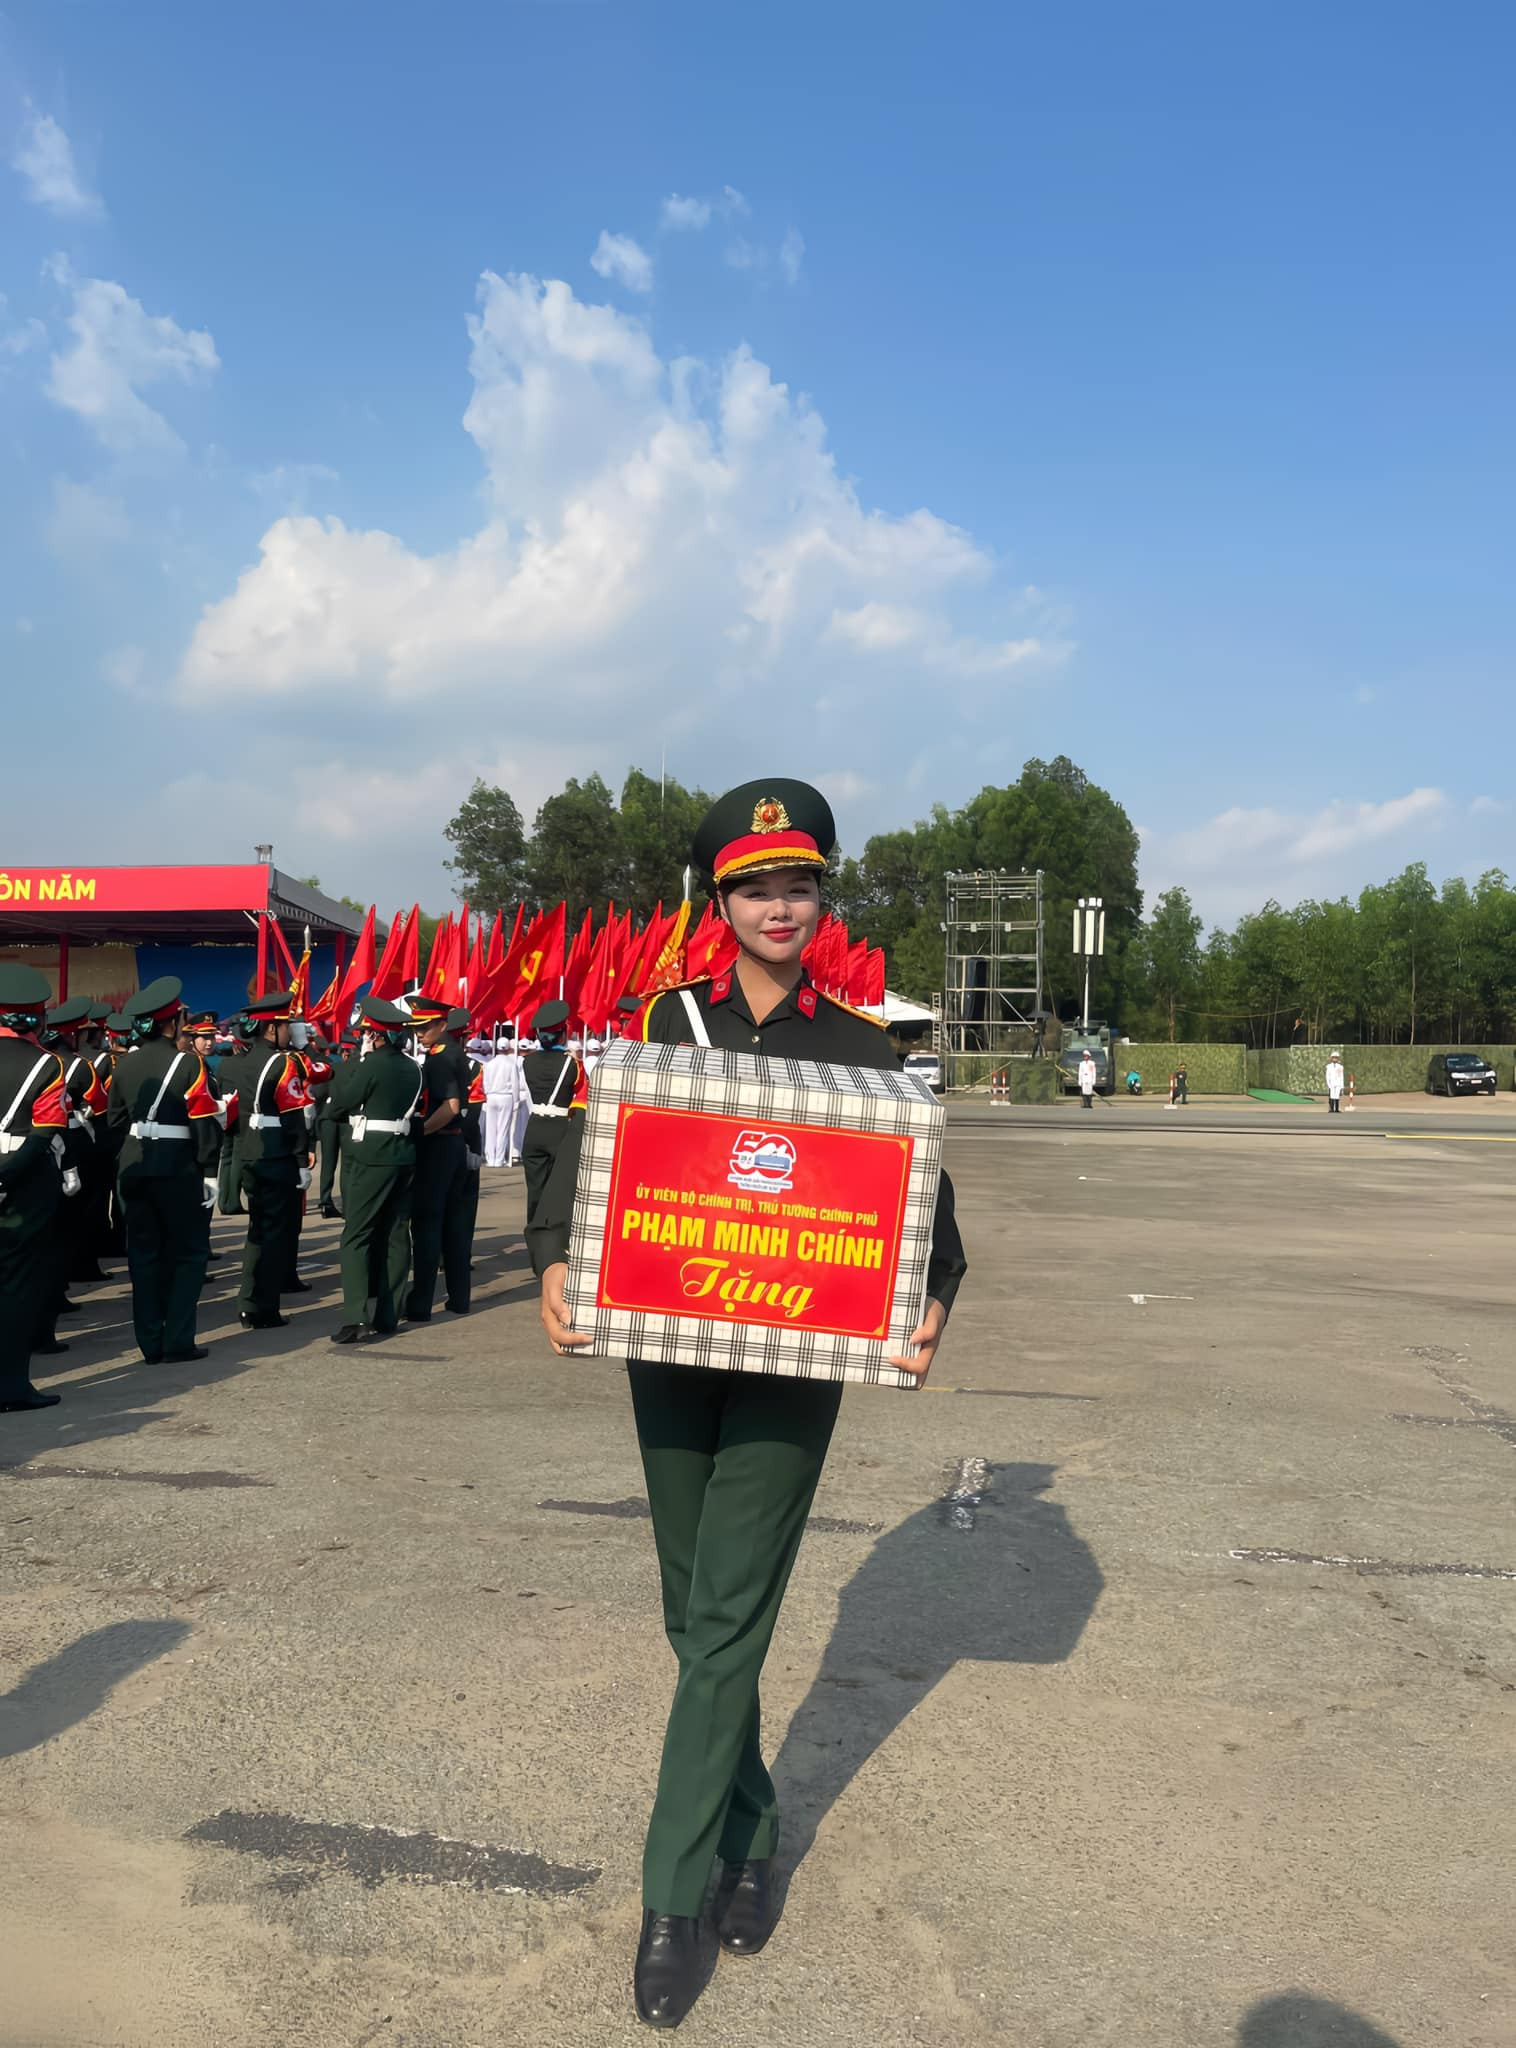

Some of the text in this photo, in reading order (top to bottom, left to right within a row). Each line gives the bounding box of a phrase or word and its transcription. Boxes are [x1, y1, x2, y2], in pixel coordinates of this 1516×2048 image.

[39, 873, 96, 901] NĂM
[636, 1182, 650, 1199] ỦY
[653, 1187, 678, 1203] VIÊN
[681, 1190, 696, 1206] BỘ
[698, 1193, 732, 1209] CHÍNH
[735, 1197, 754, 1214] TRỊ,
[758, 1199, 779, 1215] THỦ
[820, 1207, 853, 1224] CHÍNH
[856, 1210, 878, 1227] PHỦ
[621, 1208, 885, 1269] PHẠM MINH CHÍNH
[679, 1256, 815, 1319] Tặng
